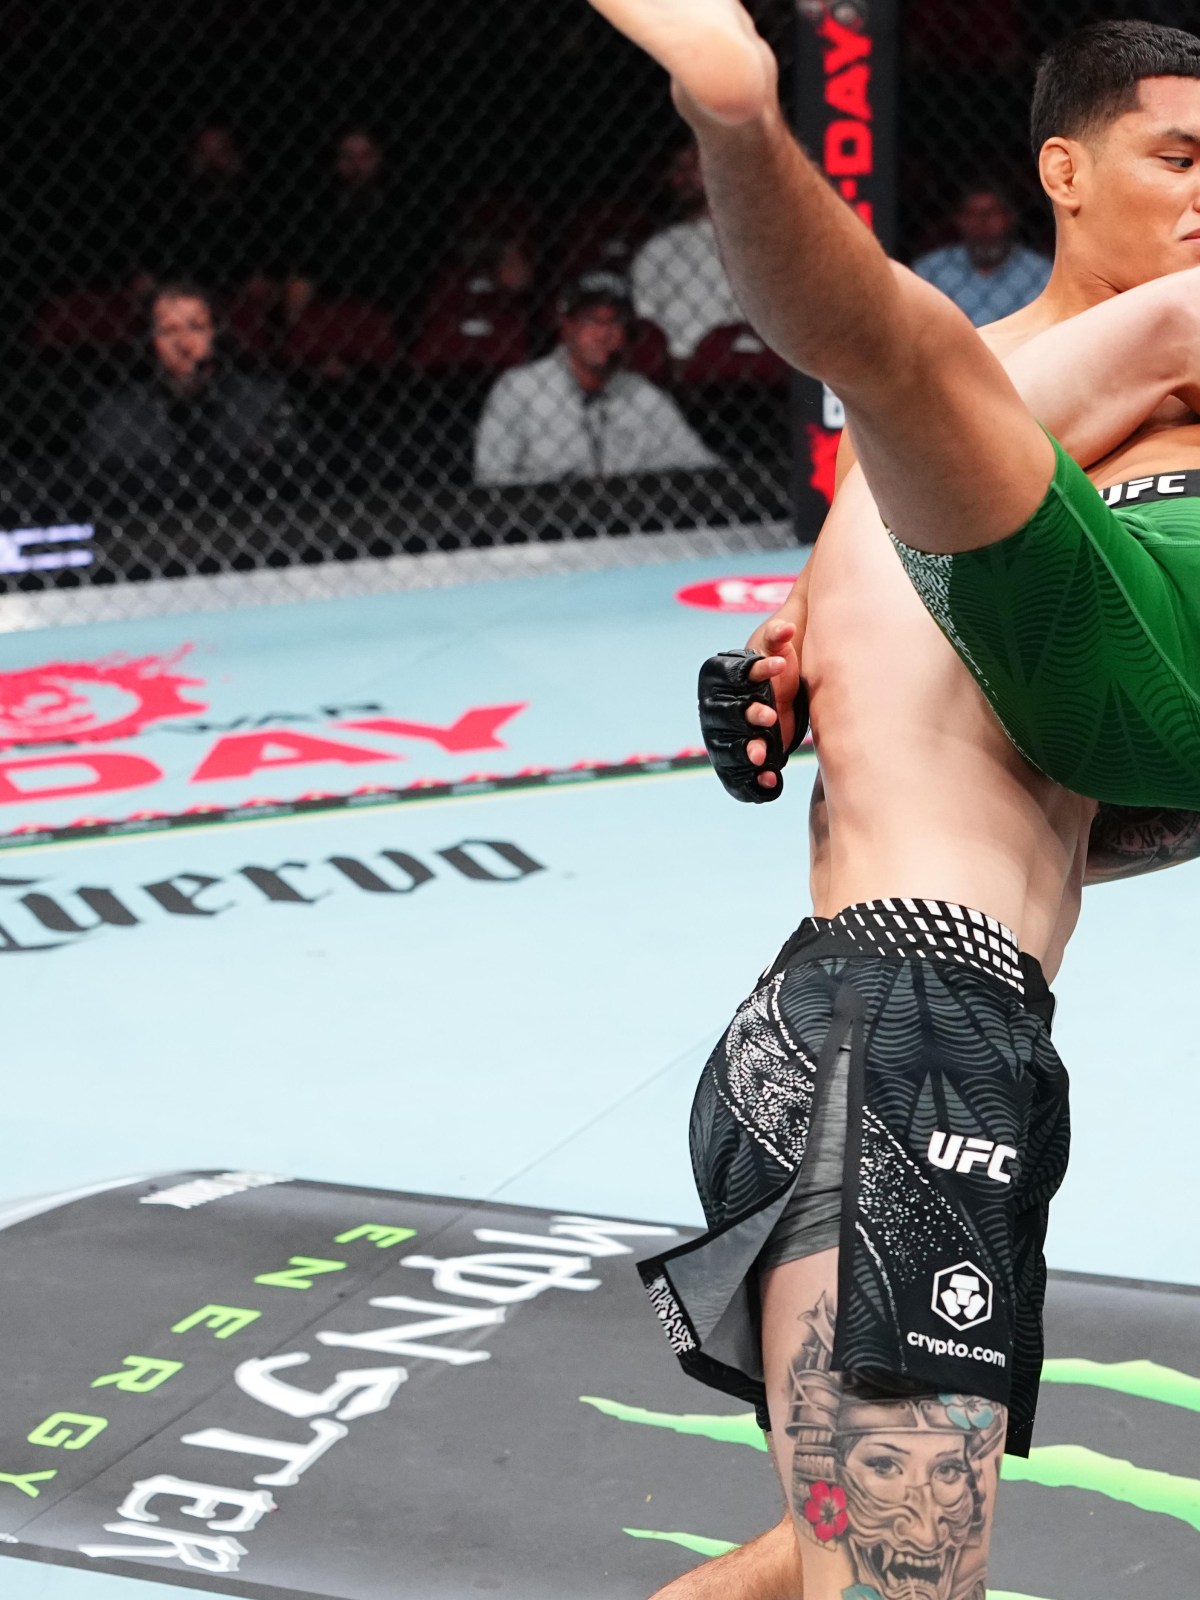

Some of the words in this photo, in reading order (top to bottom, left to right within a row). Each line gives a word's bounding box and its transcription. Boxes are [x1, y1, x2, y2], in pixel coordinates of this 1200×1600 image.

[927, 1130, 1017, 1184] UFC
[906, 1330, 1006, 1368] crypto.com
[78, 1214, 680, 1573] MONSTER
